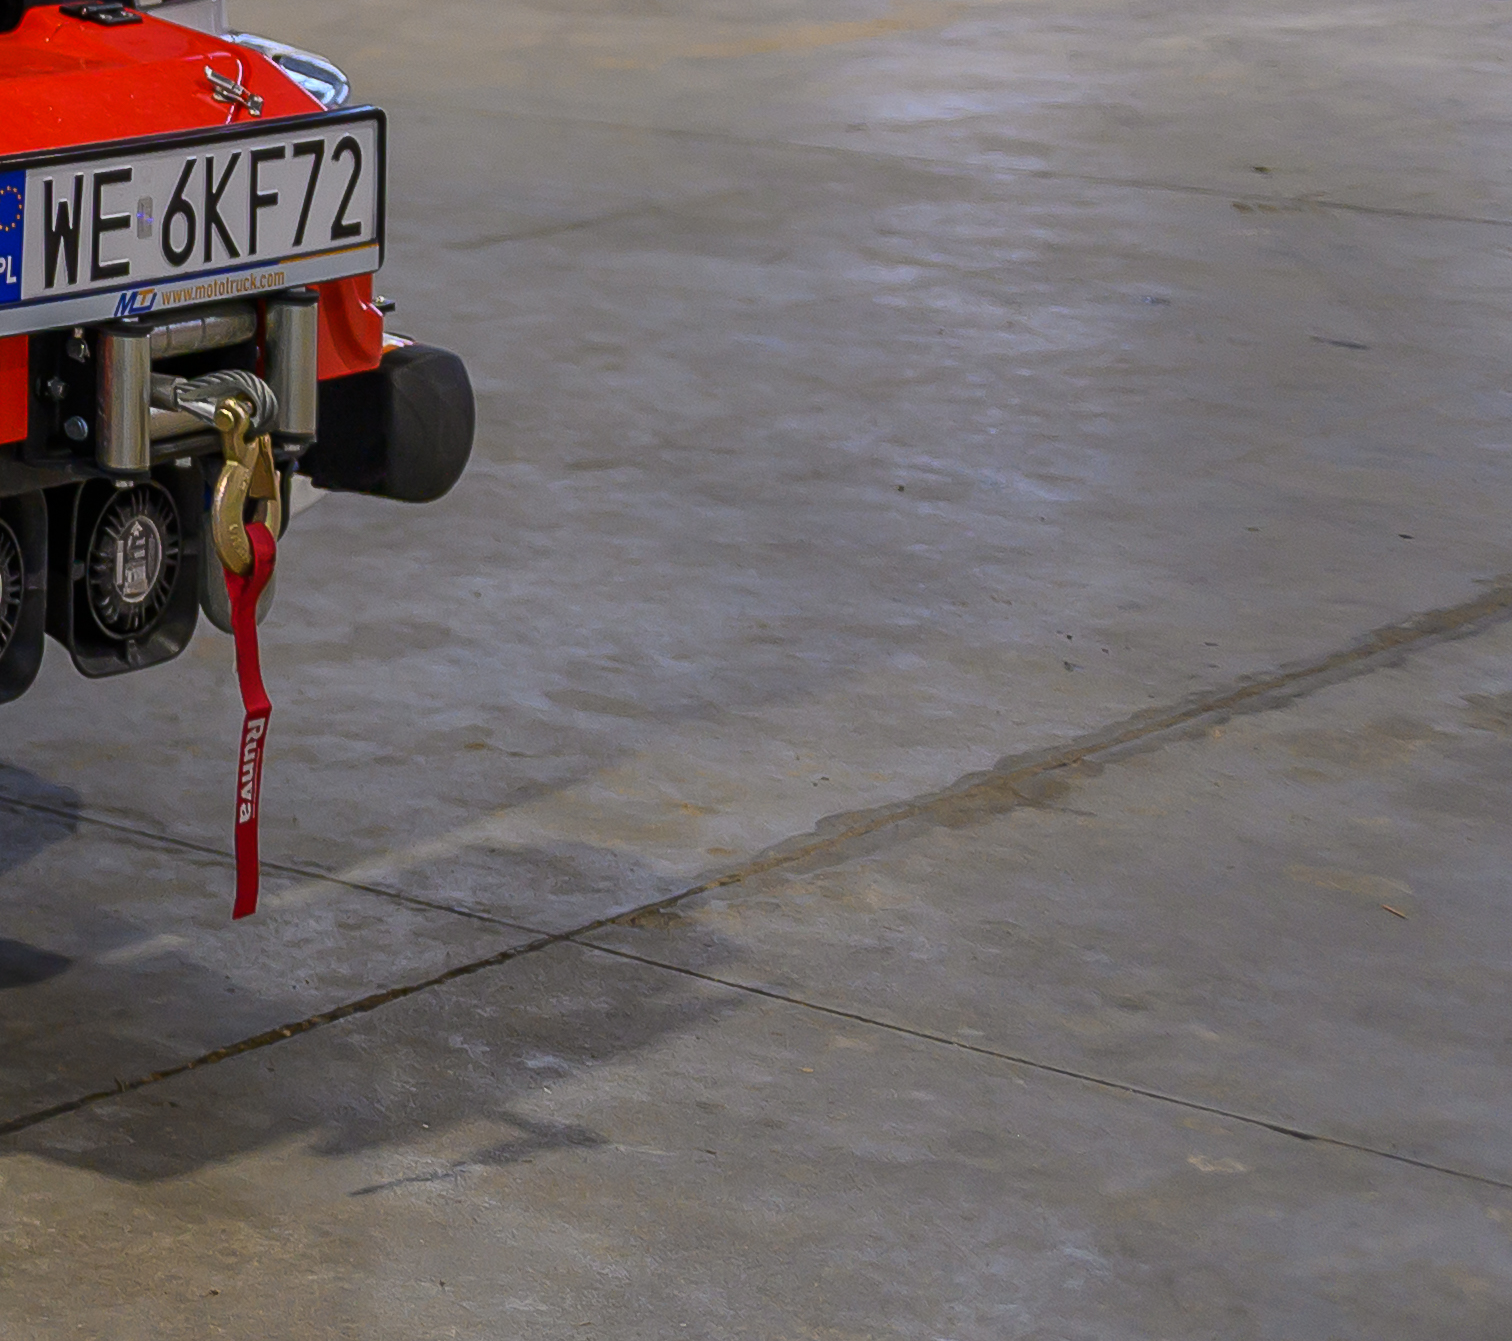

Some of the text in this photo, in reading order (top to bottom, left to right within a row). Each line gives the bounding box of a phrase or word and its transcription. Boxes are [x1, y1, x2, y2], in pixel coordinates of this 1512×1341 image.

[43, 134, 363, 290] WE 6KF72
[161, 270, 286, 306] www.mototruck.com
[239, 717, 266, 824] Runva
